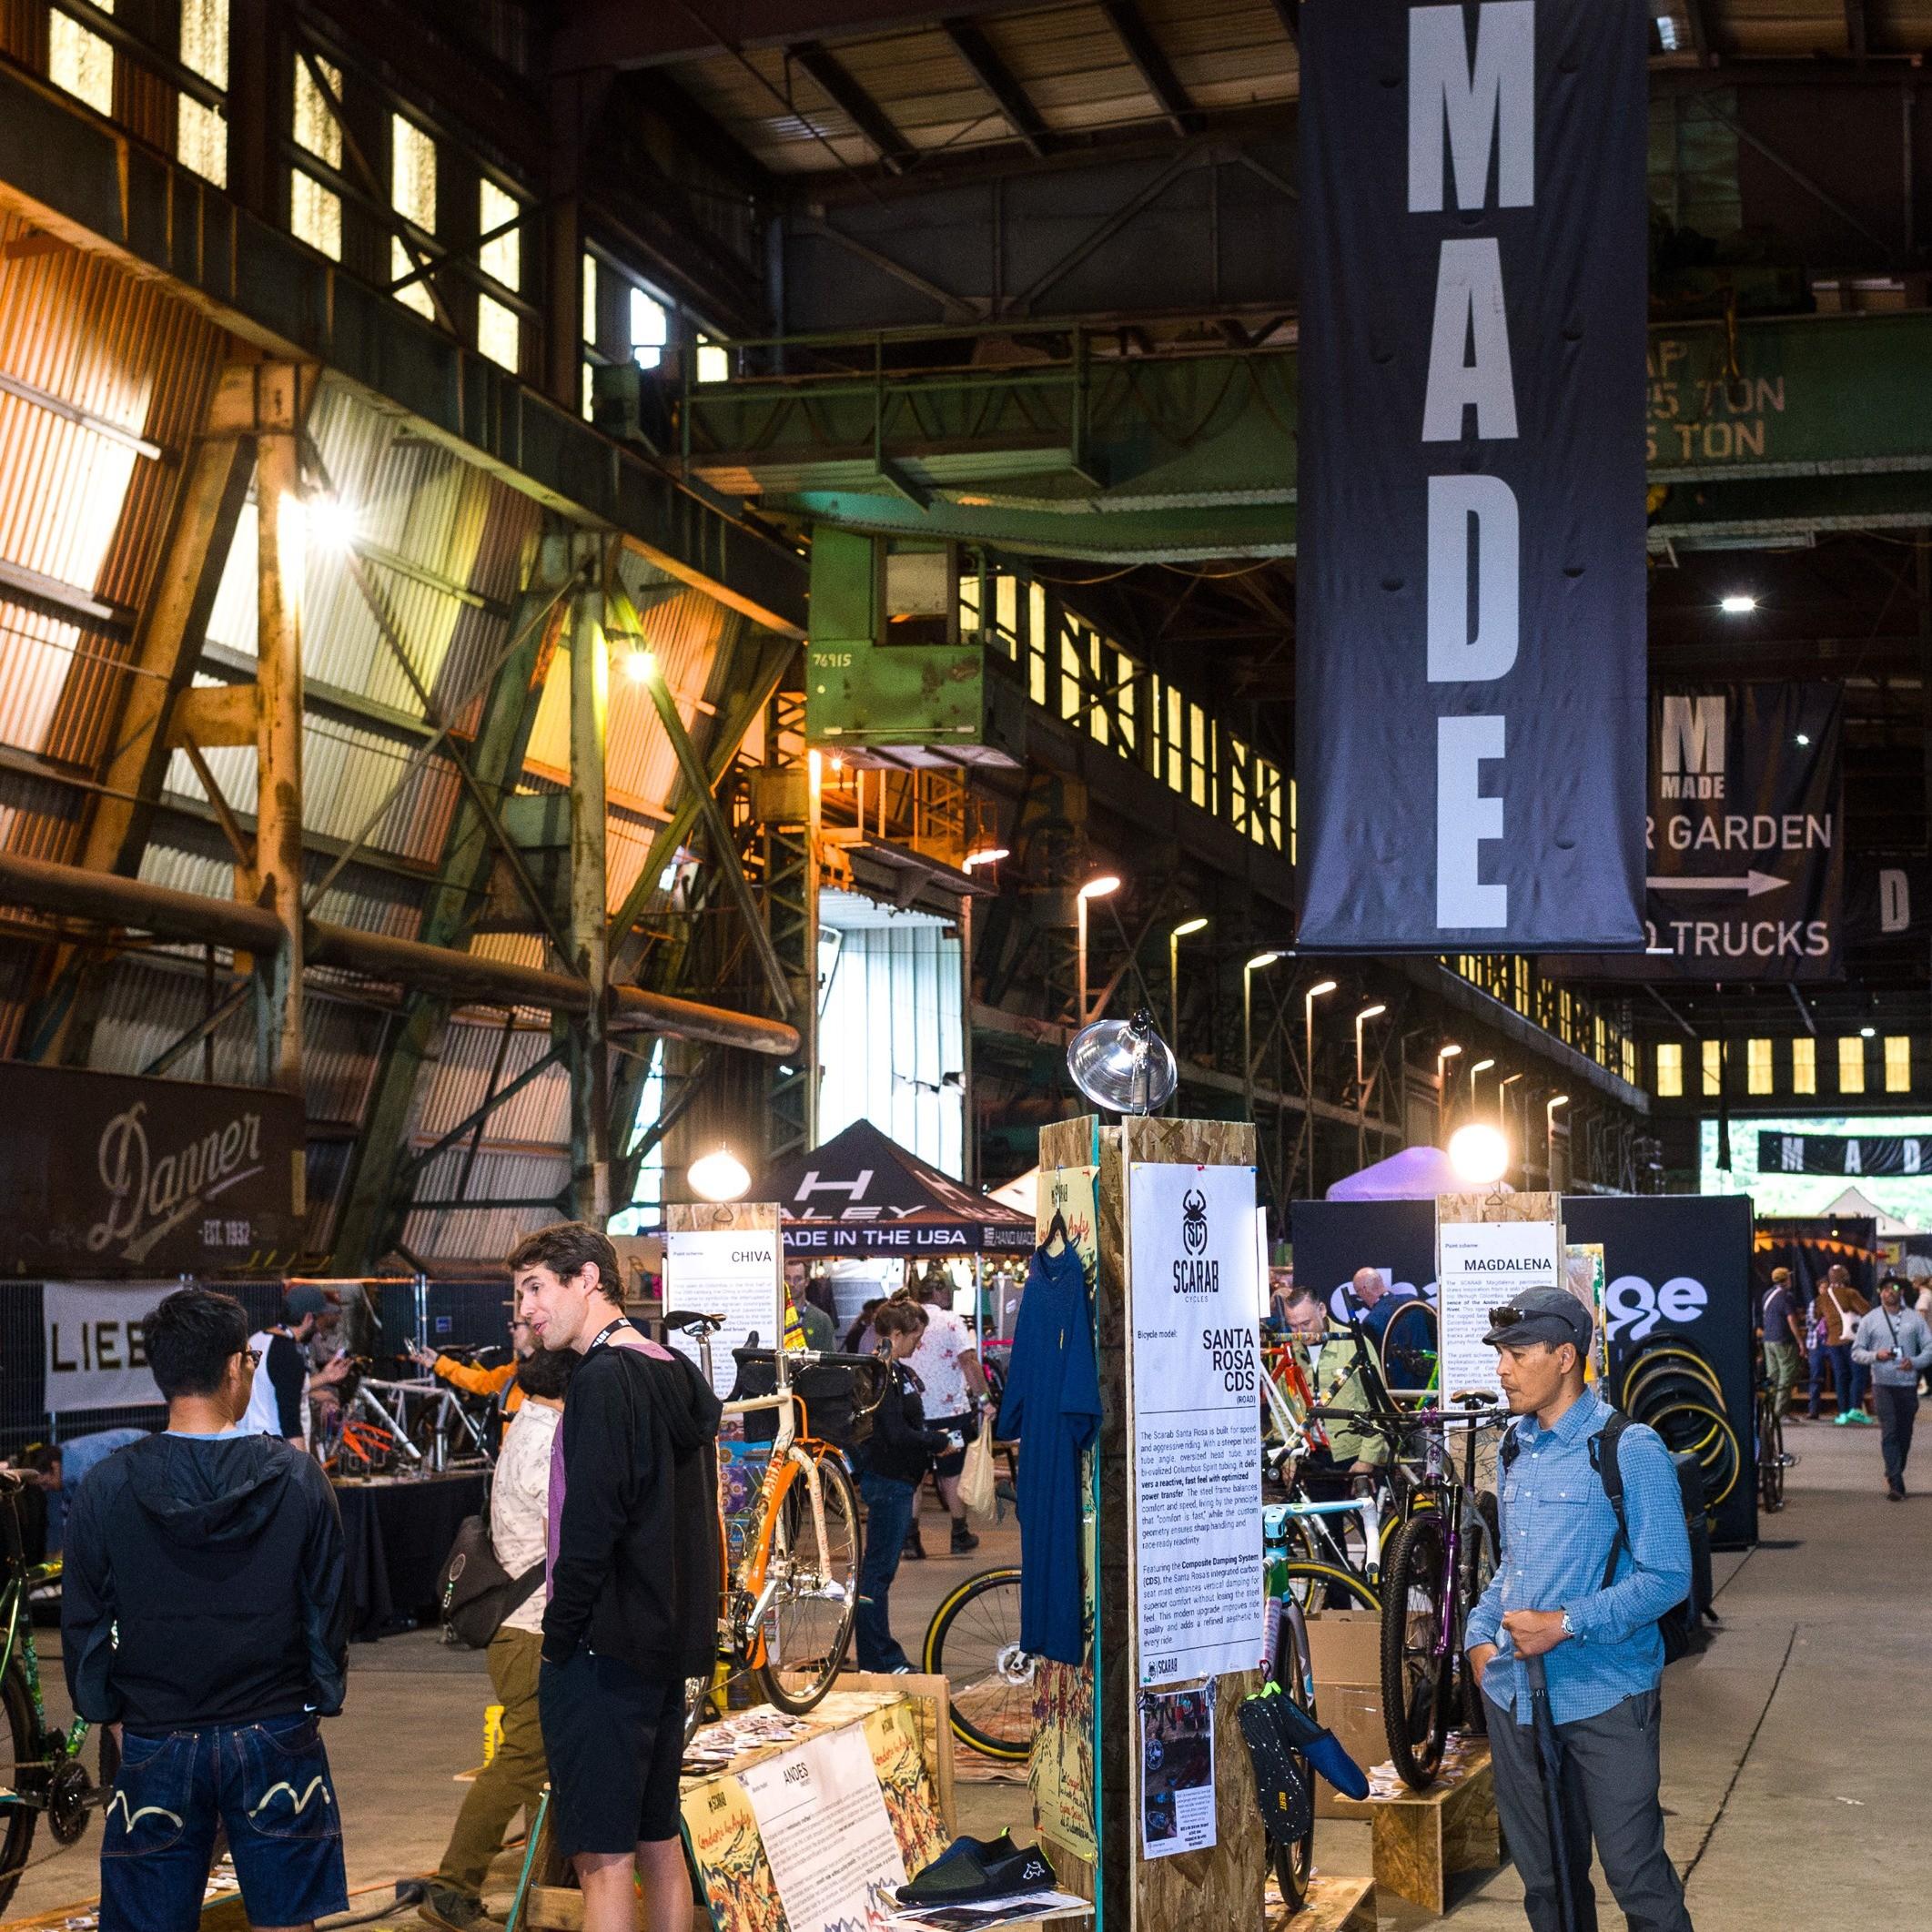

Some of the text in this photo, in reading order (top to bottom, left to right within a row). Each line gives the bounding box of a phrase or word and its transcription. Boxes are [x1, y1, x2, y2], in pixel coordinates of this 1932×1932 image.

[1674, 420, 1765, 460] TON
[1408, 1, 1535, 928] MADE
[813, 653, 852, 668] 76915
[1661, 775, 1725, 800] MADE
[1668, 814, 1832, 851] GARDEN
[1670, 920, 1830, 956] TRUCKS
[88, 1101, 262, 1252] Danner
[783, 1230, 827, 1246] ADE
[834, 1230, 857, 1246] IN
[863, 1230, 910, 1245] THE
[916, 1230, 966, 1245] USA
[732, 1251, 772, 1262] CHIVA
[1464, 1259, 1552, 1270] MAGDALENA
[1173, 1259, 1219, 1293] SCARAB
[1138, 1330, 1157, 1340] Bicycle
[1203, 1329, 1254, 1350] SANTA
[1212, 1350, 1255, 1371] ROSA
[1224, 1371, 1255, 1391] CDS
[1236, 1395, 1256, 1404] (ROAD)
[783, 1762, 809, 1784] ANDES
